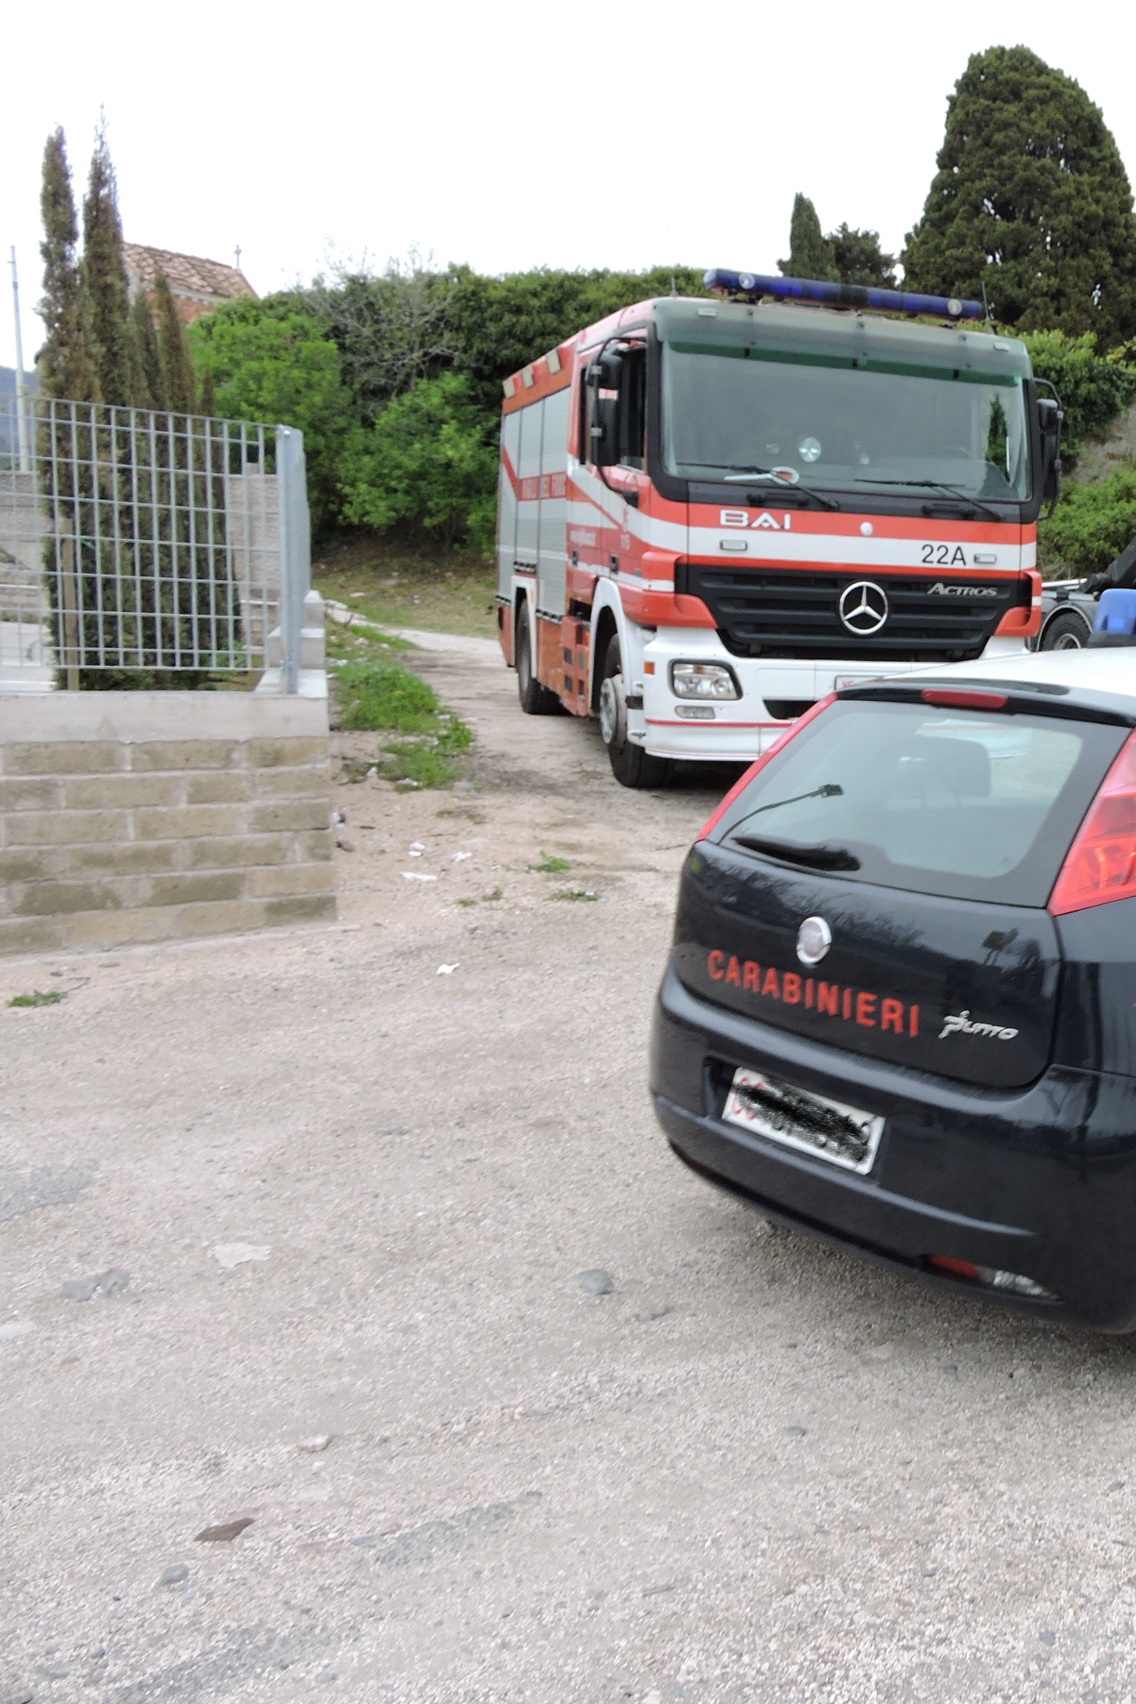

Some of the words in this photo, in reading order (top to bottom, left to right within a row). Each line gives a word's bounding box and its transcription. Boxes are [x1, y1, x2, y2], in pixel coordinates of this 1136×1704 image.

[720, 509, 791, 530] BAI
[921, 544, 967, 566] 22A
[706, 950, 920, 1038] CARABINIERI
